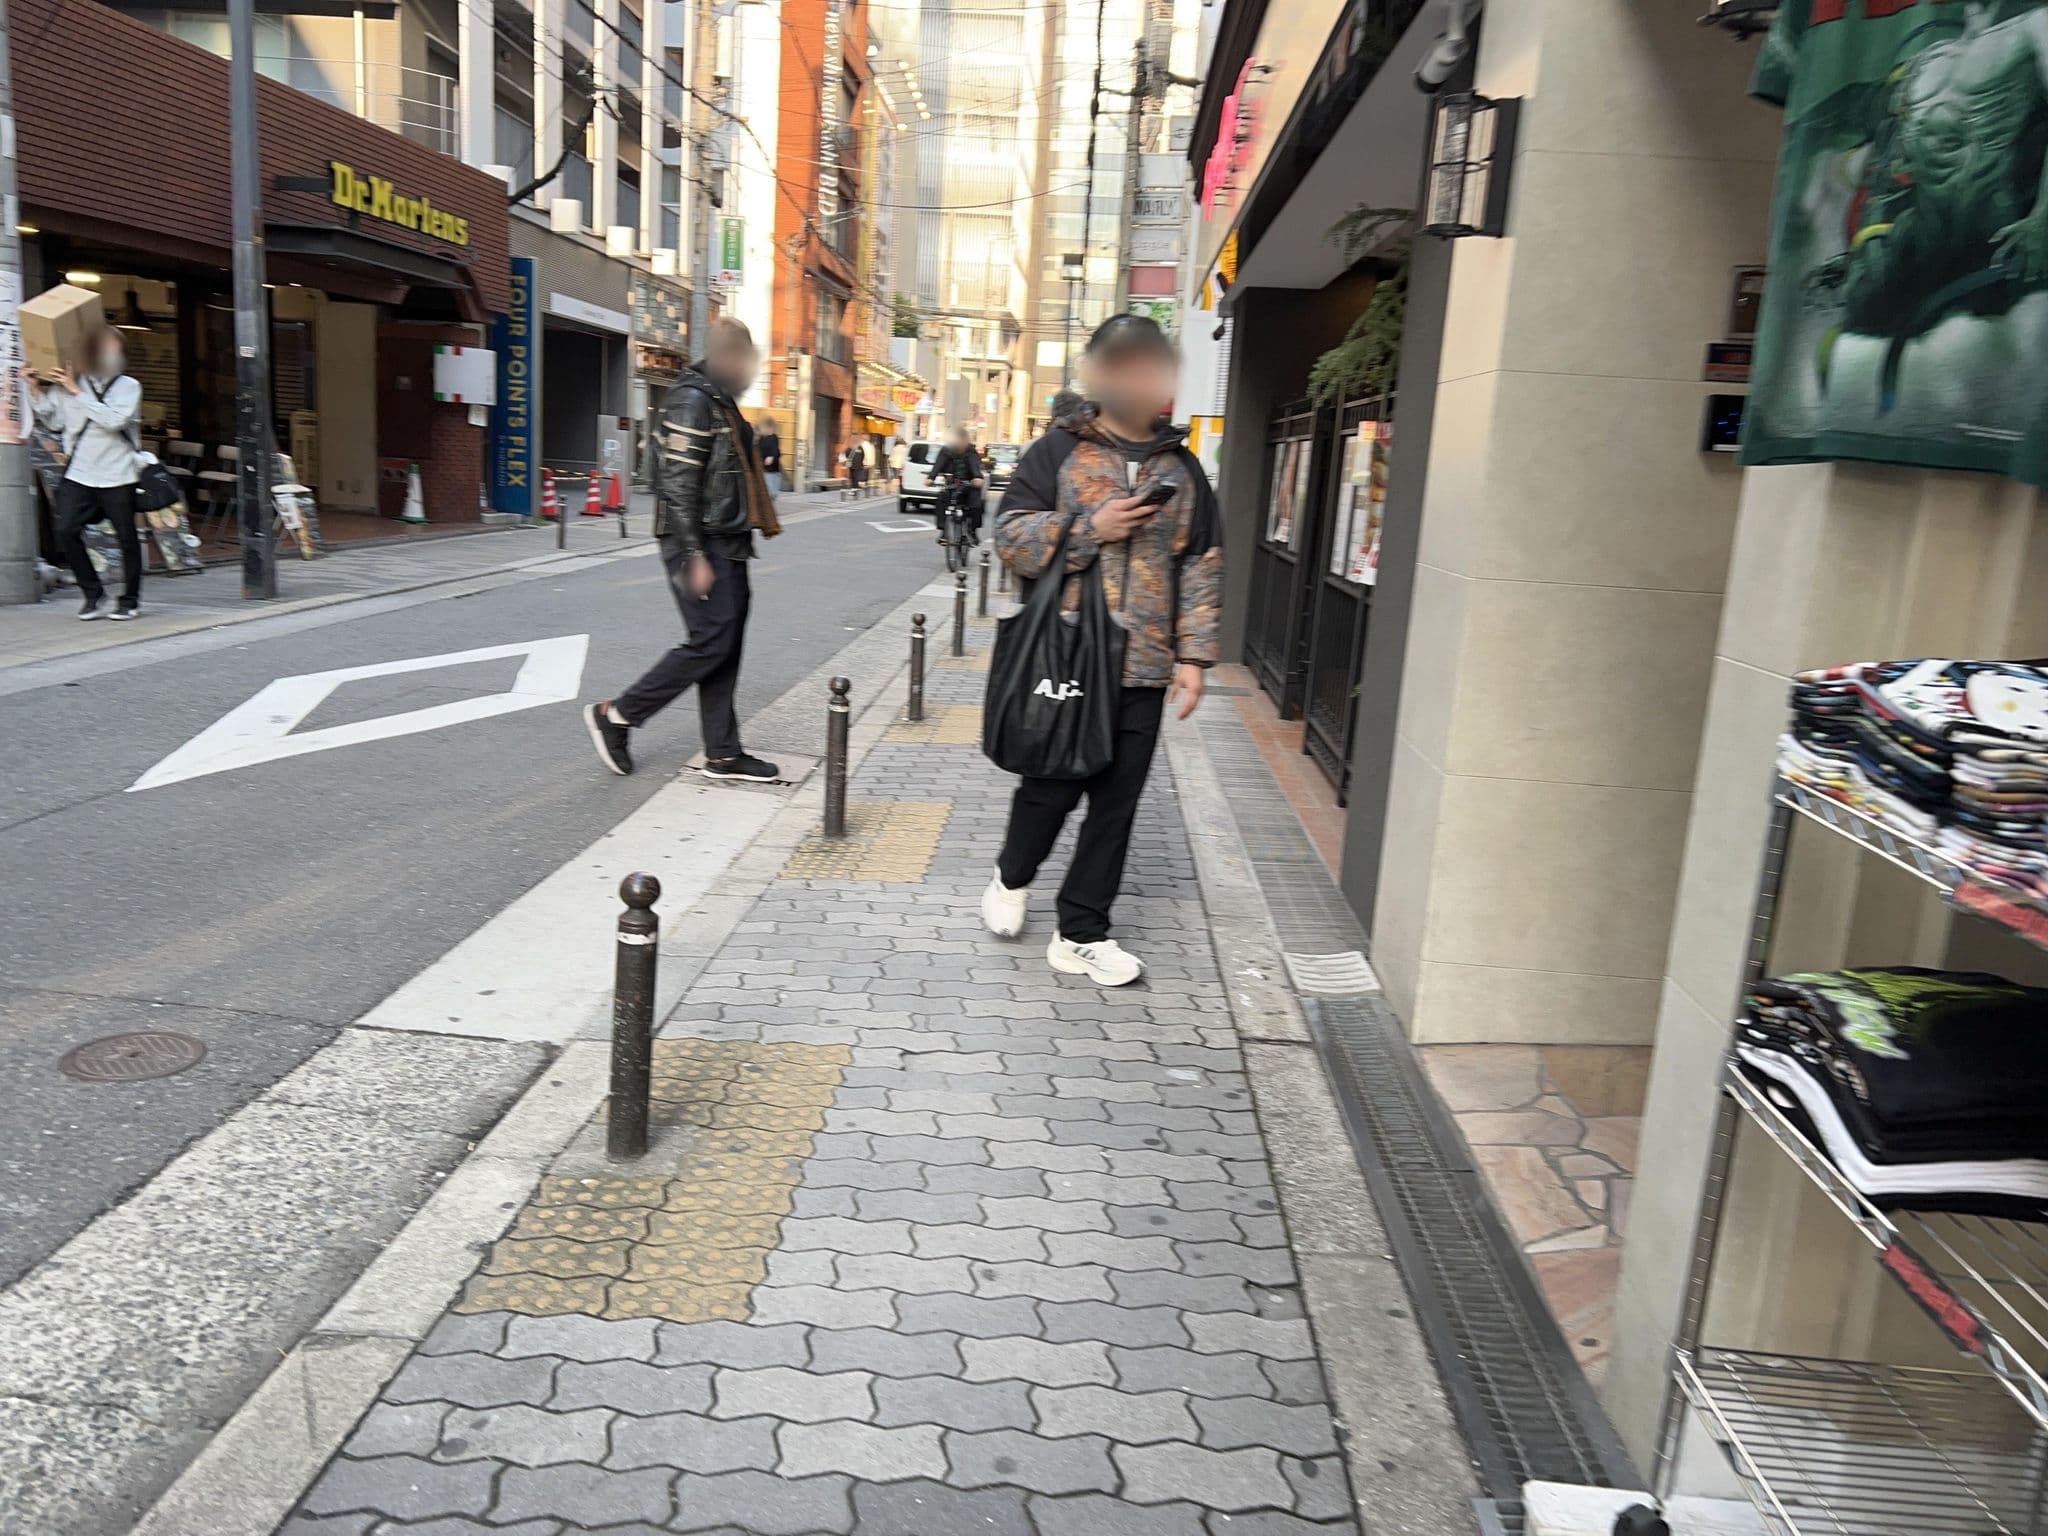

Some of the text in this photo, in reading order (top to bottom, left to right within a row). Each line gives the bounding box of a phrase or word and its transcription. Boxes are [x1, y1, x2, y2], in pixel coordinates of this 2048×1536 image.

[823, 11, 840, 49] new
[818, 173, 838, 215] BLD
[507, 275, 528, 487] FOUR POINTS FLEX
[603, 439, 621, 457] P
